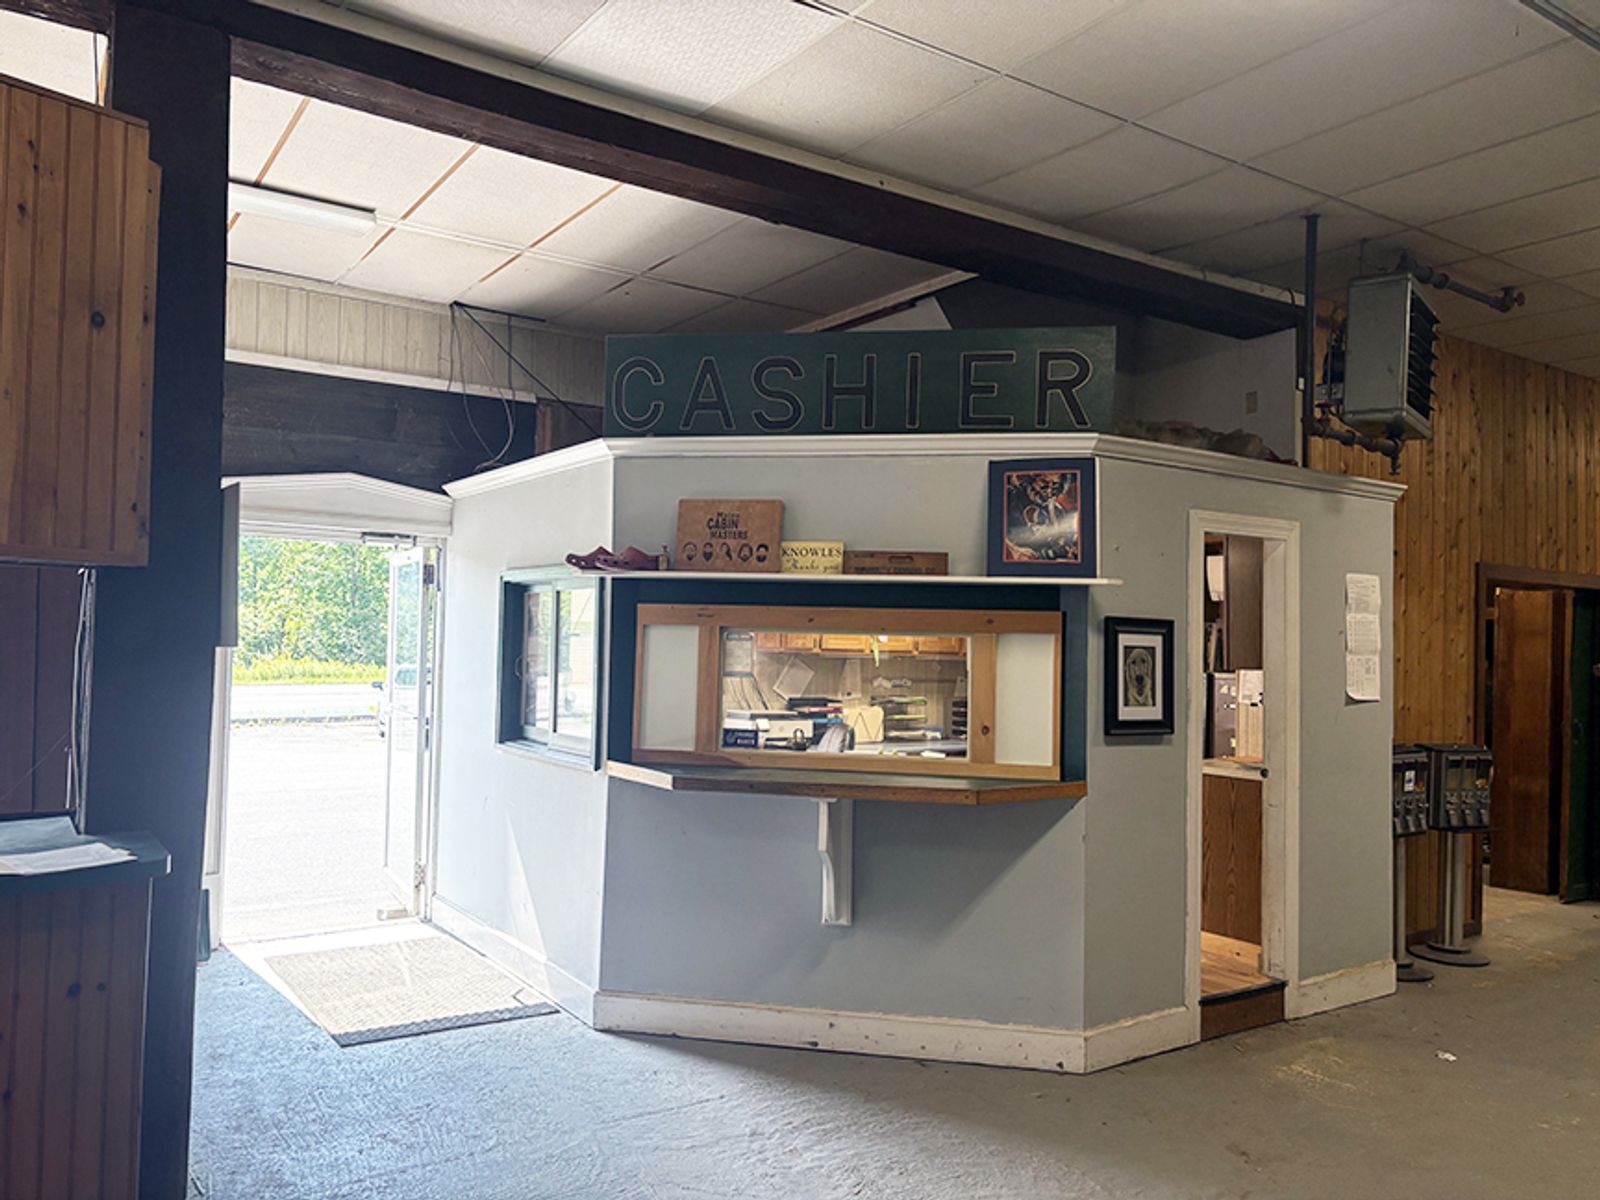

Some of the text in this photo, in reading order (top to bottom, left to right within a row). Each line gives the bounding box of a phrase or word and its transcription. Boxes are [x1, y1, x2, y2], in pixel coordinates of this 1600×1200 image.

[610, 348, 1094, 431] CASHIER
[707, 517, 739, 530] CABIN
[711, 529, 748, 540] MASTERS
[782, 547, 842, 558] KNOWLES
